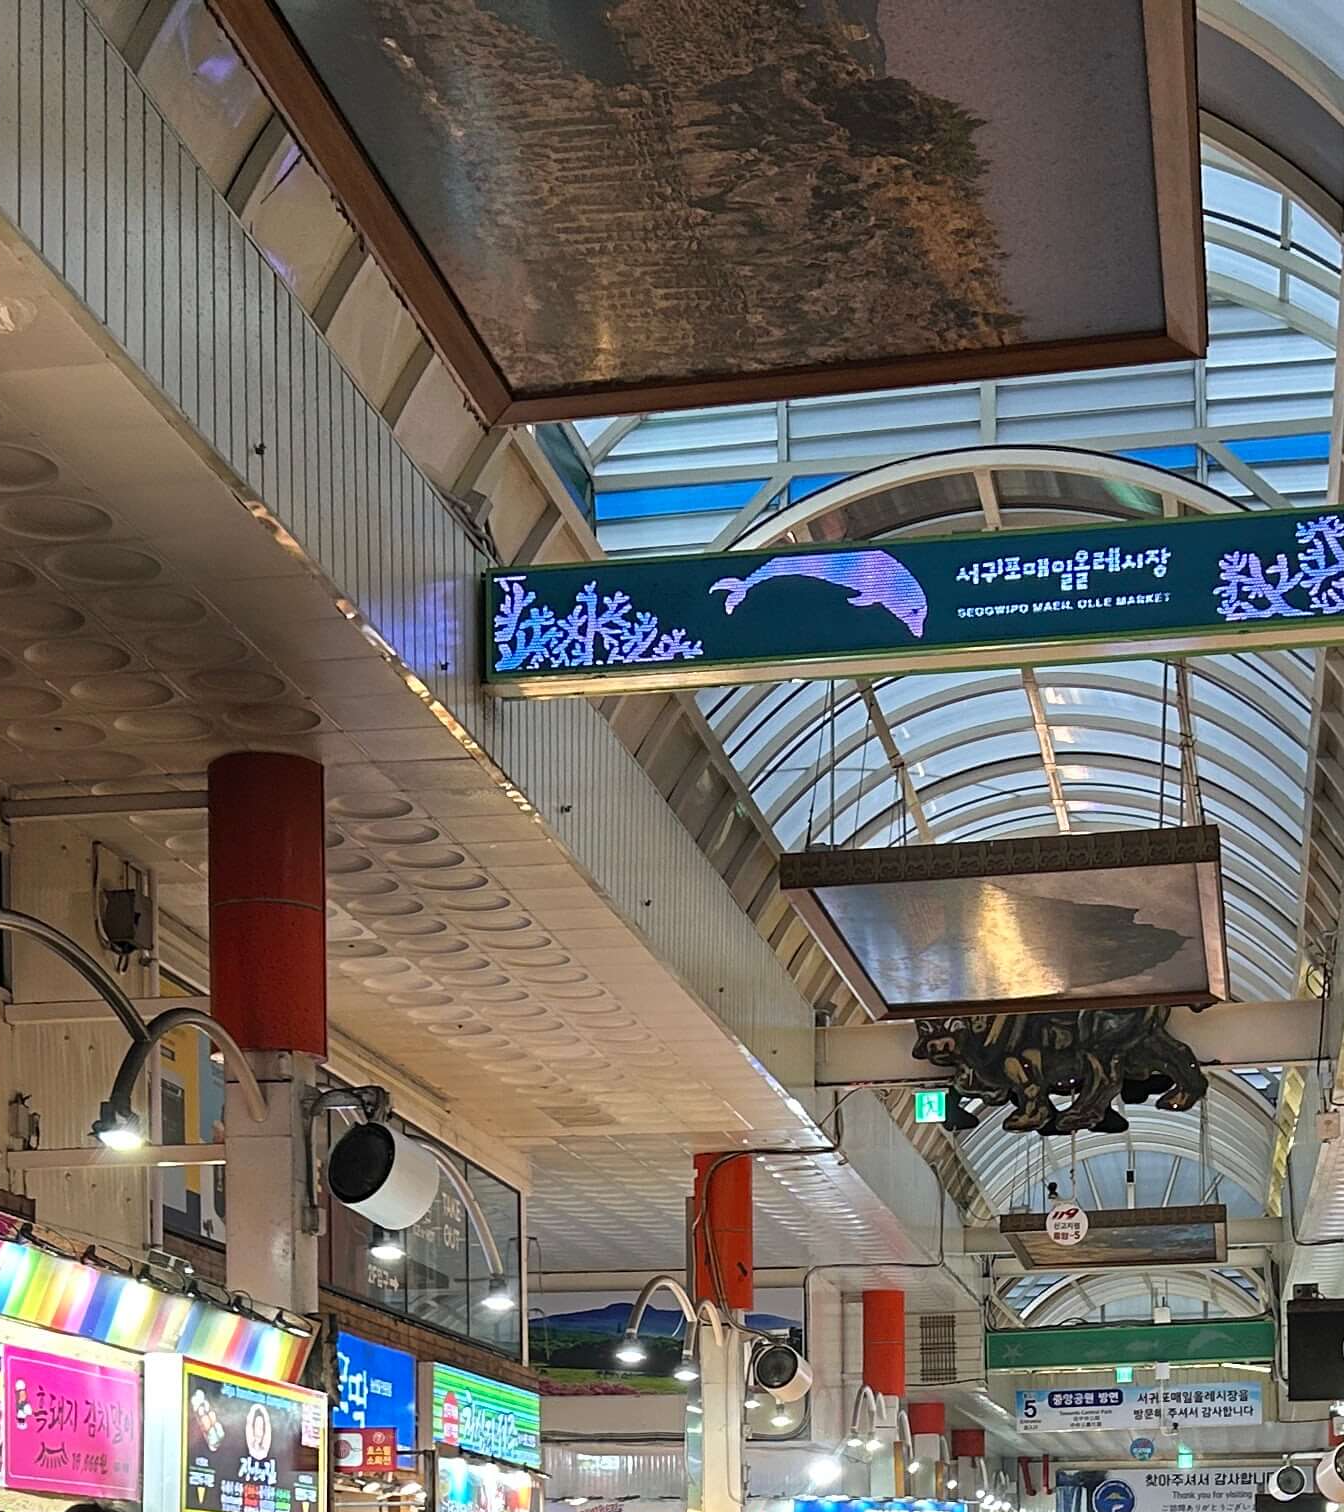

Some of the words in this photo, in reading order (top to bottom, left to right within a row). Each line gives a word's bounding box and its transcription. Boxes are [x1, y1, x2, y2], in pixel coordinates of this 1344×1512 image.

[955, 547, 1172, 591] 서귀포매일올레시장
[957, 604, 1029, 618] SEOGWIPO
[1077, 597, 1112, 610] OLLE
[1116, 592, 1172, 607] MARKET
[1052, 1207, 1079, 1219] 119
[1053, 1393, 1094, 1406] 중앙공원
[1098, 1391, 1119, 1404] 방면
[1024, 1400, 1036, 1418] 5
[1201, 1405, 1254, 1417] 감사합니다
[1145, 1474, 1209, 1486] 찾아주셔서
